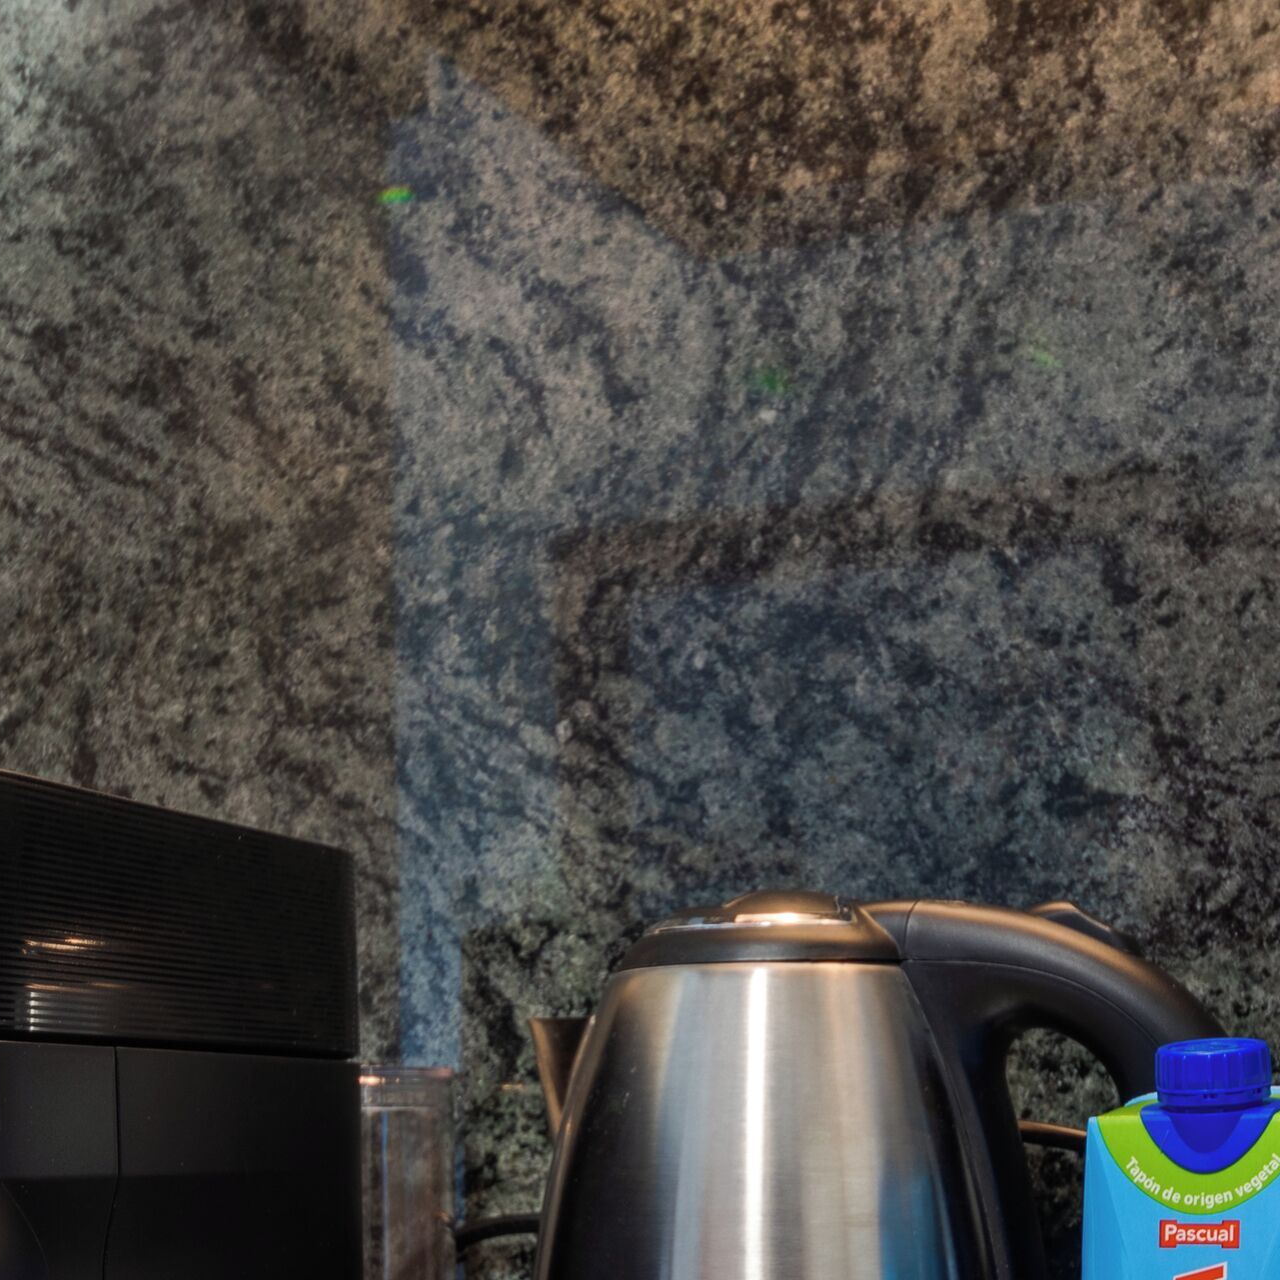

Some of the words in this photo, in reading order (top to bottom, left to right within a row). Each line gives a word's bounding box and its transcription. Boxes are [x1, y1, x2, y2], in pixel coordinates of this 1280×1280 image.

[1125, 1156, 1161, 1195] Tapón
[1162, 1186, 1182, 1204] de
[1183, 1190, 1234, 1209] origen
[1164, 1223, 1235, 1242] Pascual
